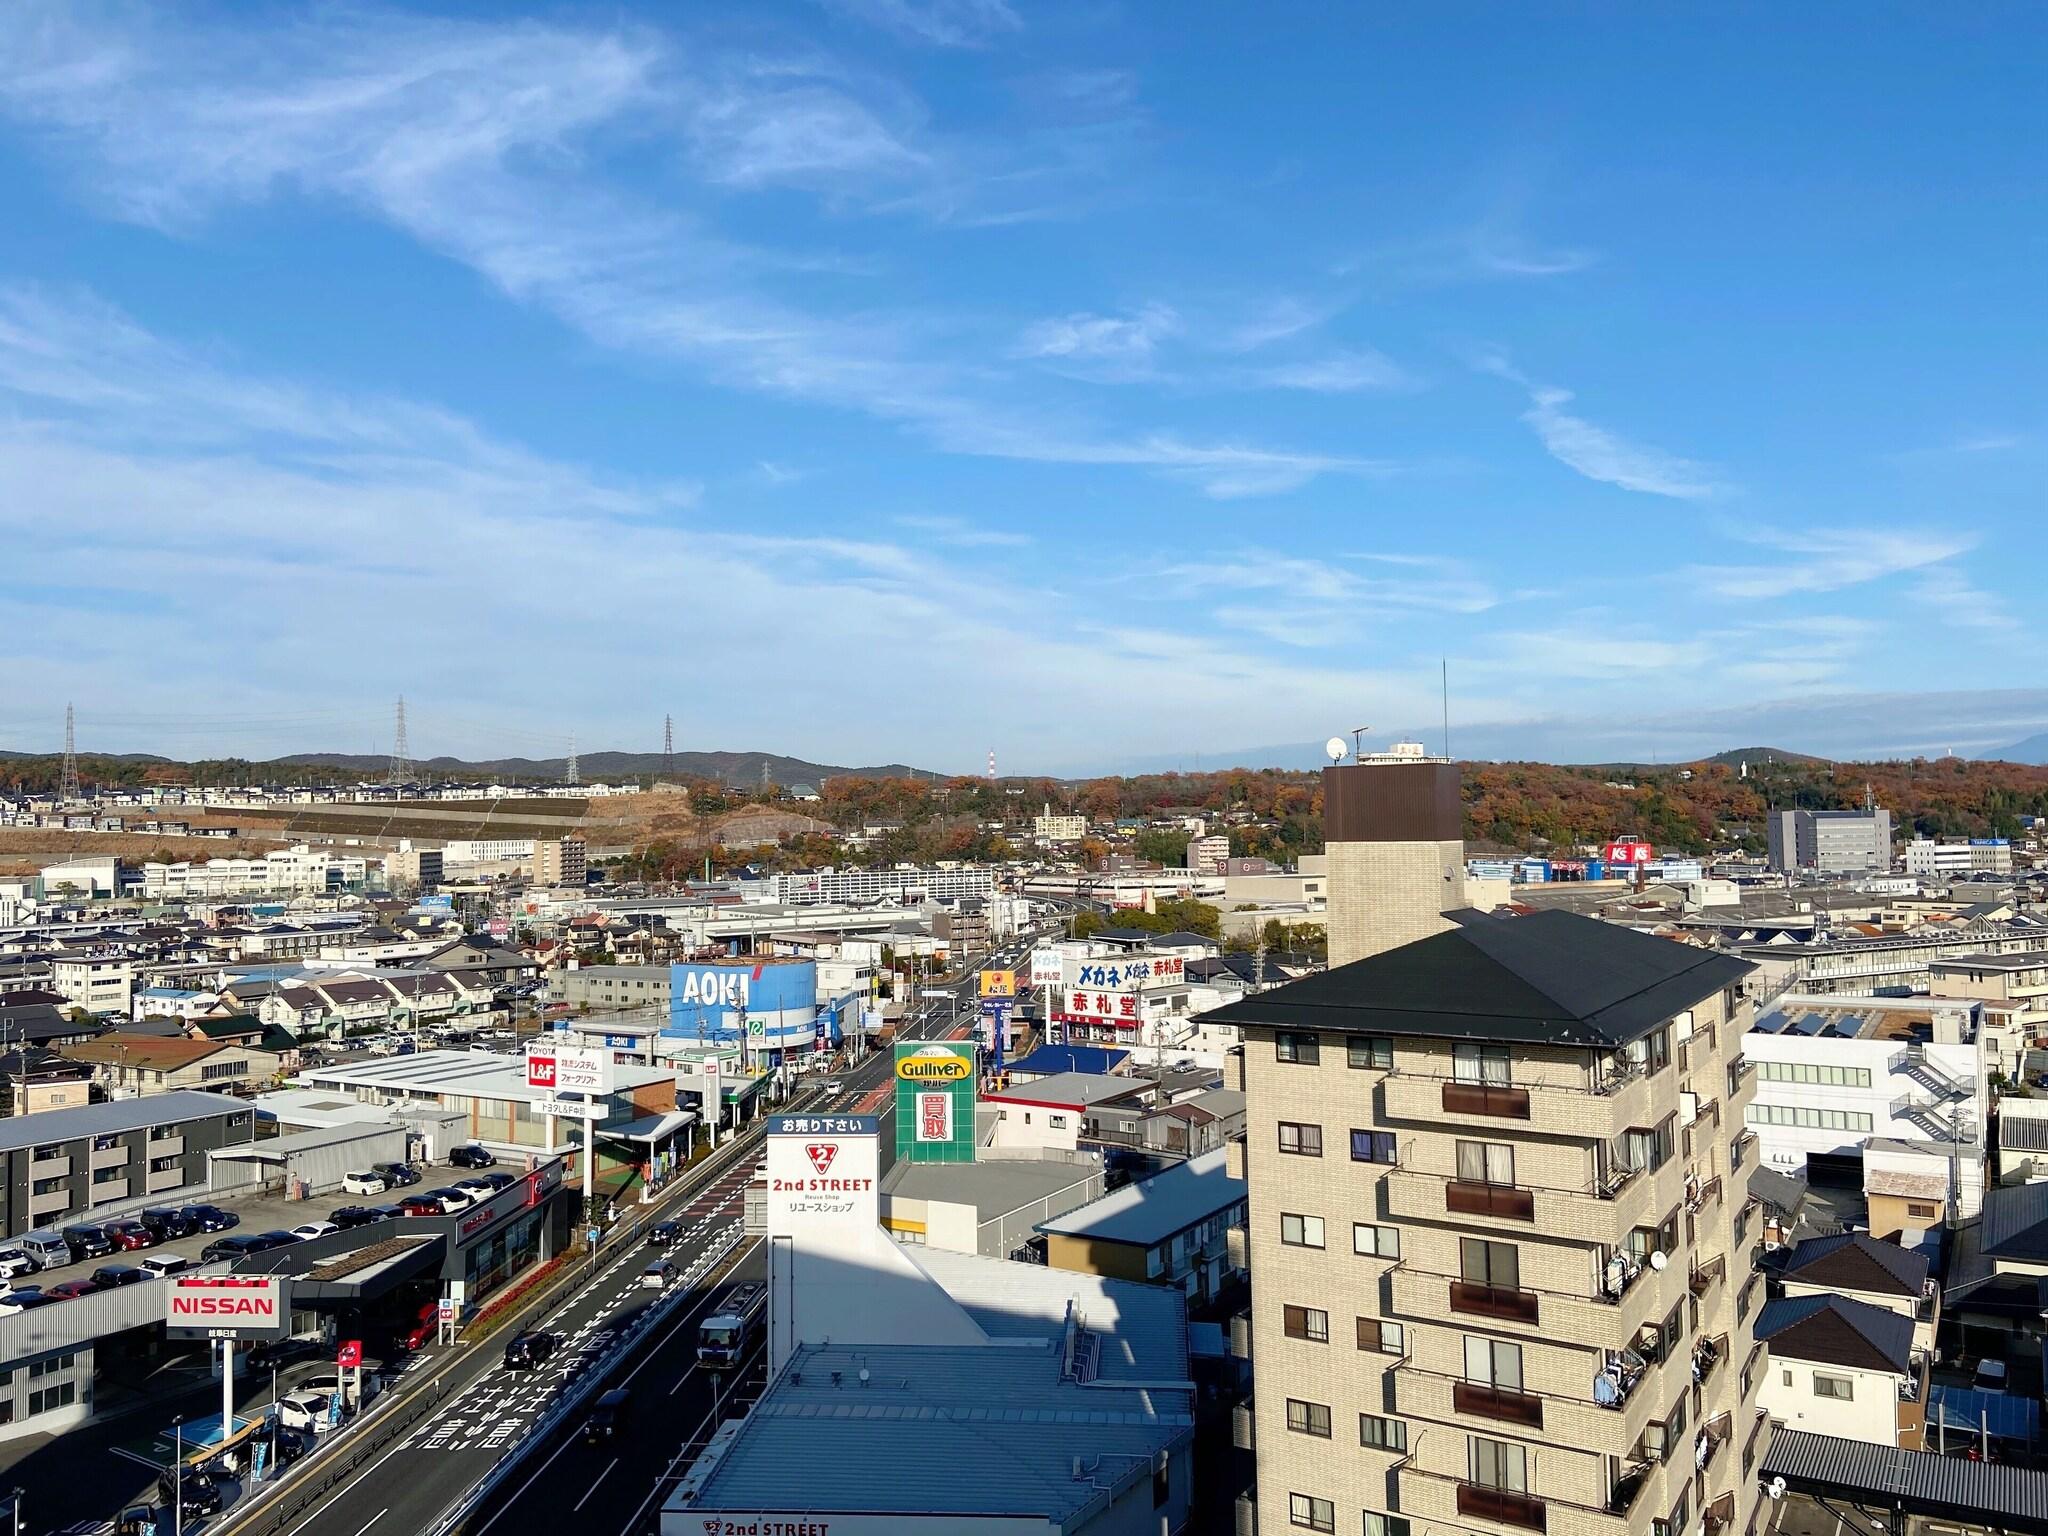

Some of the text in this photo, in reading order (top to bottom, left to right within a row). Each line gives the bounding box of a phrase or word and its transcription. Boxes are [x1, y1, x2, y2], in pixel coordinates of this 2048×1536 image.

[1153, 957, 1183, 976] 赤札堂
[1034, 971, 1061, 981] 赤札堂
[682, 971, 749, 1007] AOKI
[1073, 992, 1136, 1017] 赤札堂
[611, 1036, 628, 1047] AOKI
[528, 1046, 556, 1056] TOYOTA
[530, 1063, 554, 1080] L&F
[901, 1062, 966, 1076] Gulliver
[561, 1073, 597, 1085] フォークリフト
[922, 1094, 947, 1139] 買取
[782, 1119, 862, 1132] お売り下さい
[773, 1179, 872, 1191] 2nd STREET
[789, 1202, 854, 1213] リユースショップ
[173, 1297, 273, 1315] NISSAN
[725, 1522, 829, 1536] 2nd STREET
